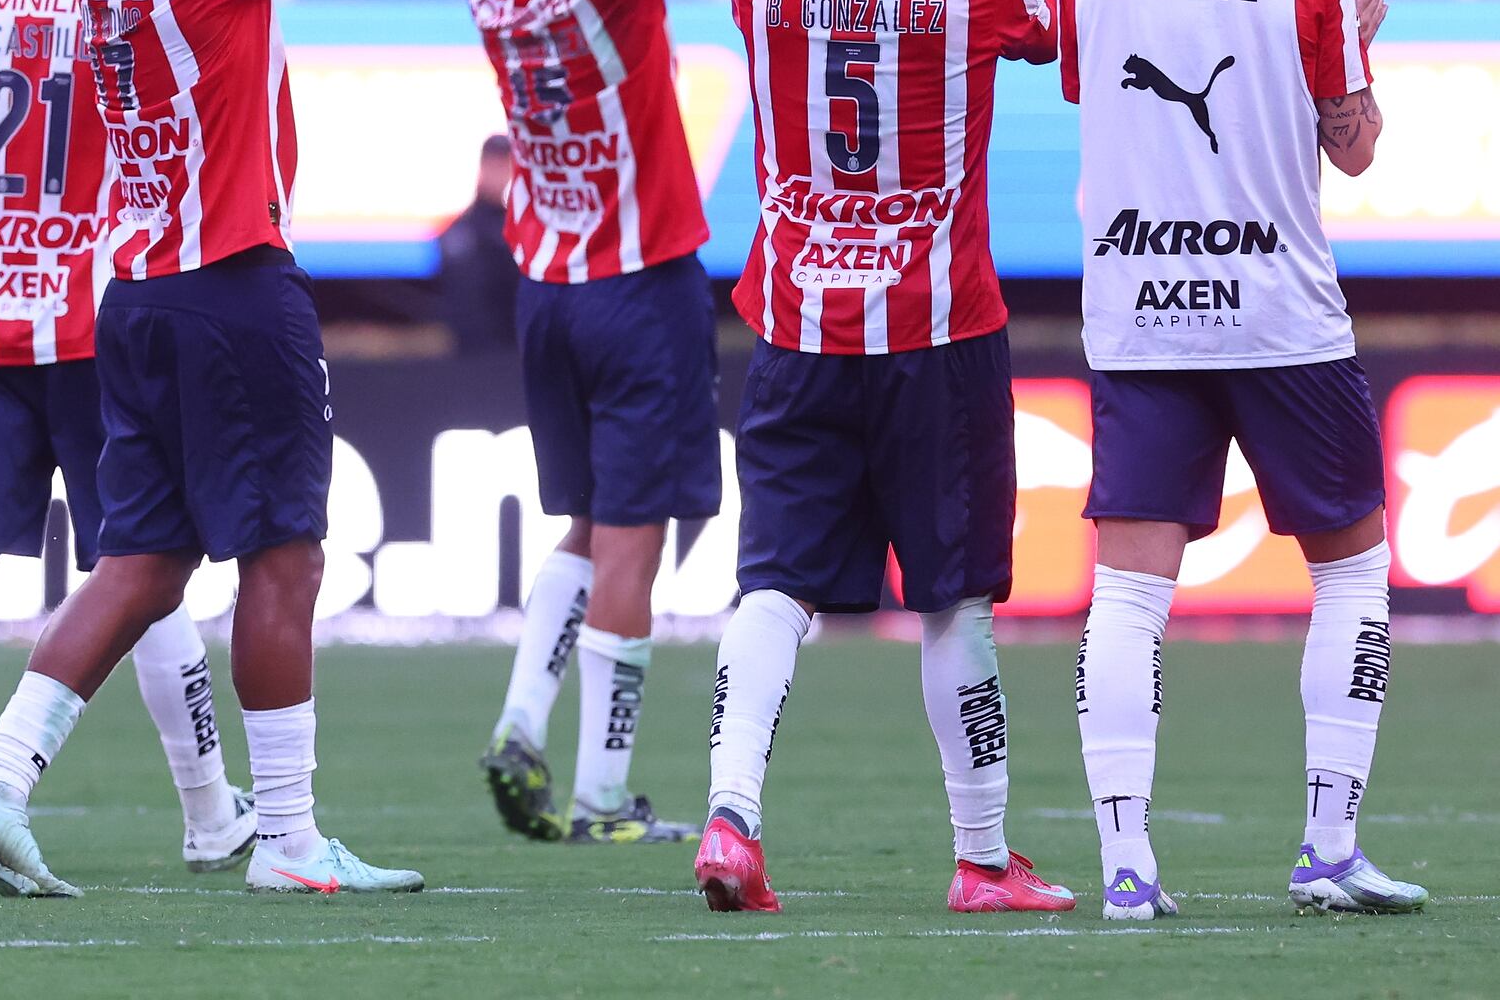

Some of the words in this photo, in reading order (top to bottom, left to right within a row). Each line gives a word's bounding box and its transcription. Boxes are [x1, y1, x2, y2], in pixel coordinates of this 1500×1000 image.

[825, 41, 880, 174] 5
[108, 117, 190, 159] RON
[765, 180, 953, 226] AKRON
[1093, 209, 1278, 256] AKRON
[800, 243, 907, 270] AXEN
[1134, 279, 1241, 311] AXEN
[1135, 315, 1242, 328] CAPITAL
[1347, 619, 1392, 704] PERDURA
[958, 675, 1007, 770] PERDURA
